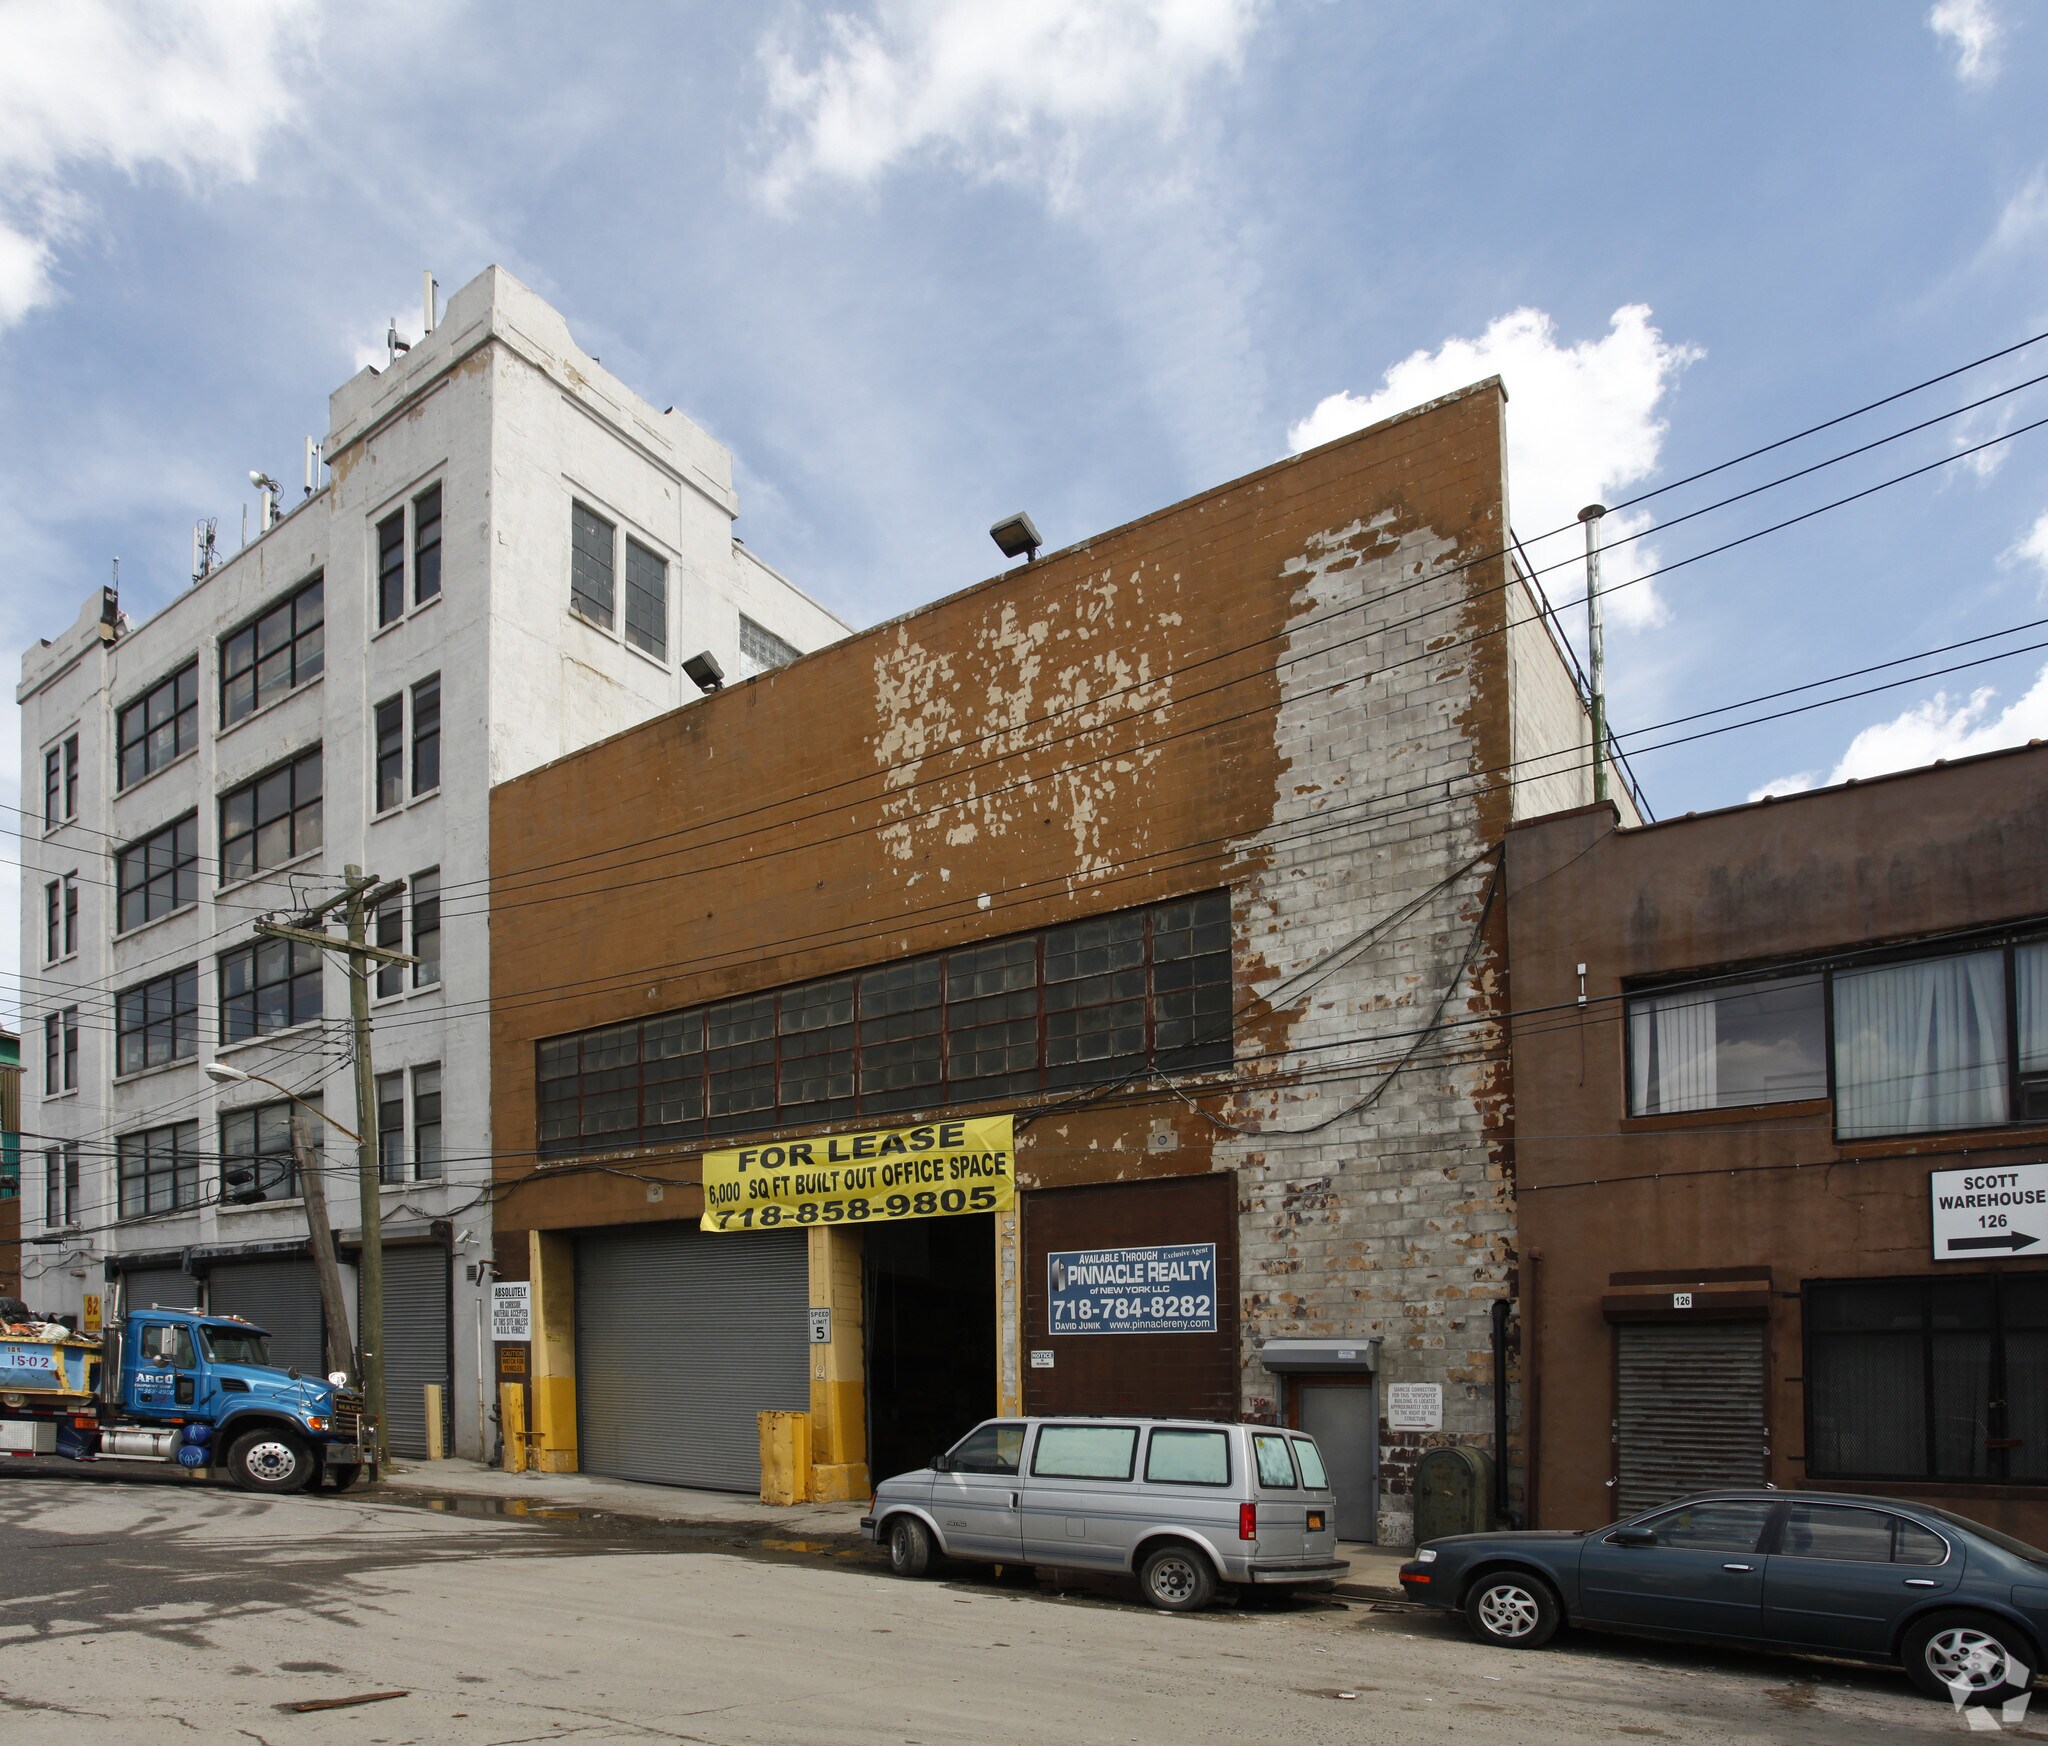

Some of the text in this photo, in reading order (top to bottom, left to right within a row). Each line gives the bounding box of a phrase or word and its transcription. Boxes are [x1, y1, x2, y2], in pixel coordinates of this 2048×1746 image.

[738, 1122, 966, 1172] FOR LEASE
[709, 1152, 1006, 1208] 6,000 SQ FT BUILT OUT OFFICE SPACE
[1964, 1173, 2018, 1190] SCOTT
[1939, 1190, 2046, 1210] WAREHOUSE
[716, 1185, 997, 1230] 718-858-9805
[1979, 1214, 2007, 1228] 126
[1079, 1251, 1158, 1265] AVAILABLE THROUGH
[1163, 1247, 1208, 1260] Exclusive Agent
[1068, 1260, 1211, 1286] PINNACLE REALTY
[494, 1287, 527, 1297] ABSOLUTELY
[1090, 1285, 1170, 1295] of NEW YORK LLC
[87, 1296, 98, 1315] 82
[1053, 1295, 1211, 1320] 718-784-8282
[1675, 1296, 1690, 1306] 126
[494, 1309, 528, 1317] MATERIAL ACCEPTED
[1055, 1319, 1210, 1331] DAVID JUNIK www.pinnaclereny.com
[816, 1327, 825, 1339] 5
[136, 1372, 174, 1384] ARCO
[1249, 1398, 1266, 1407] 150
